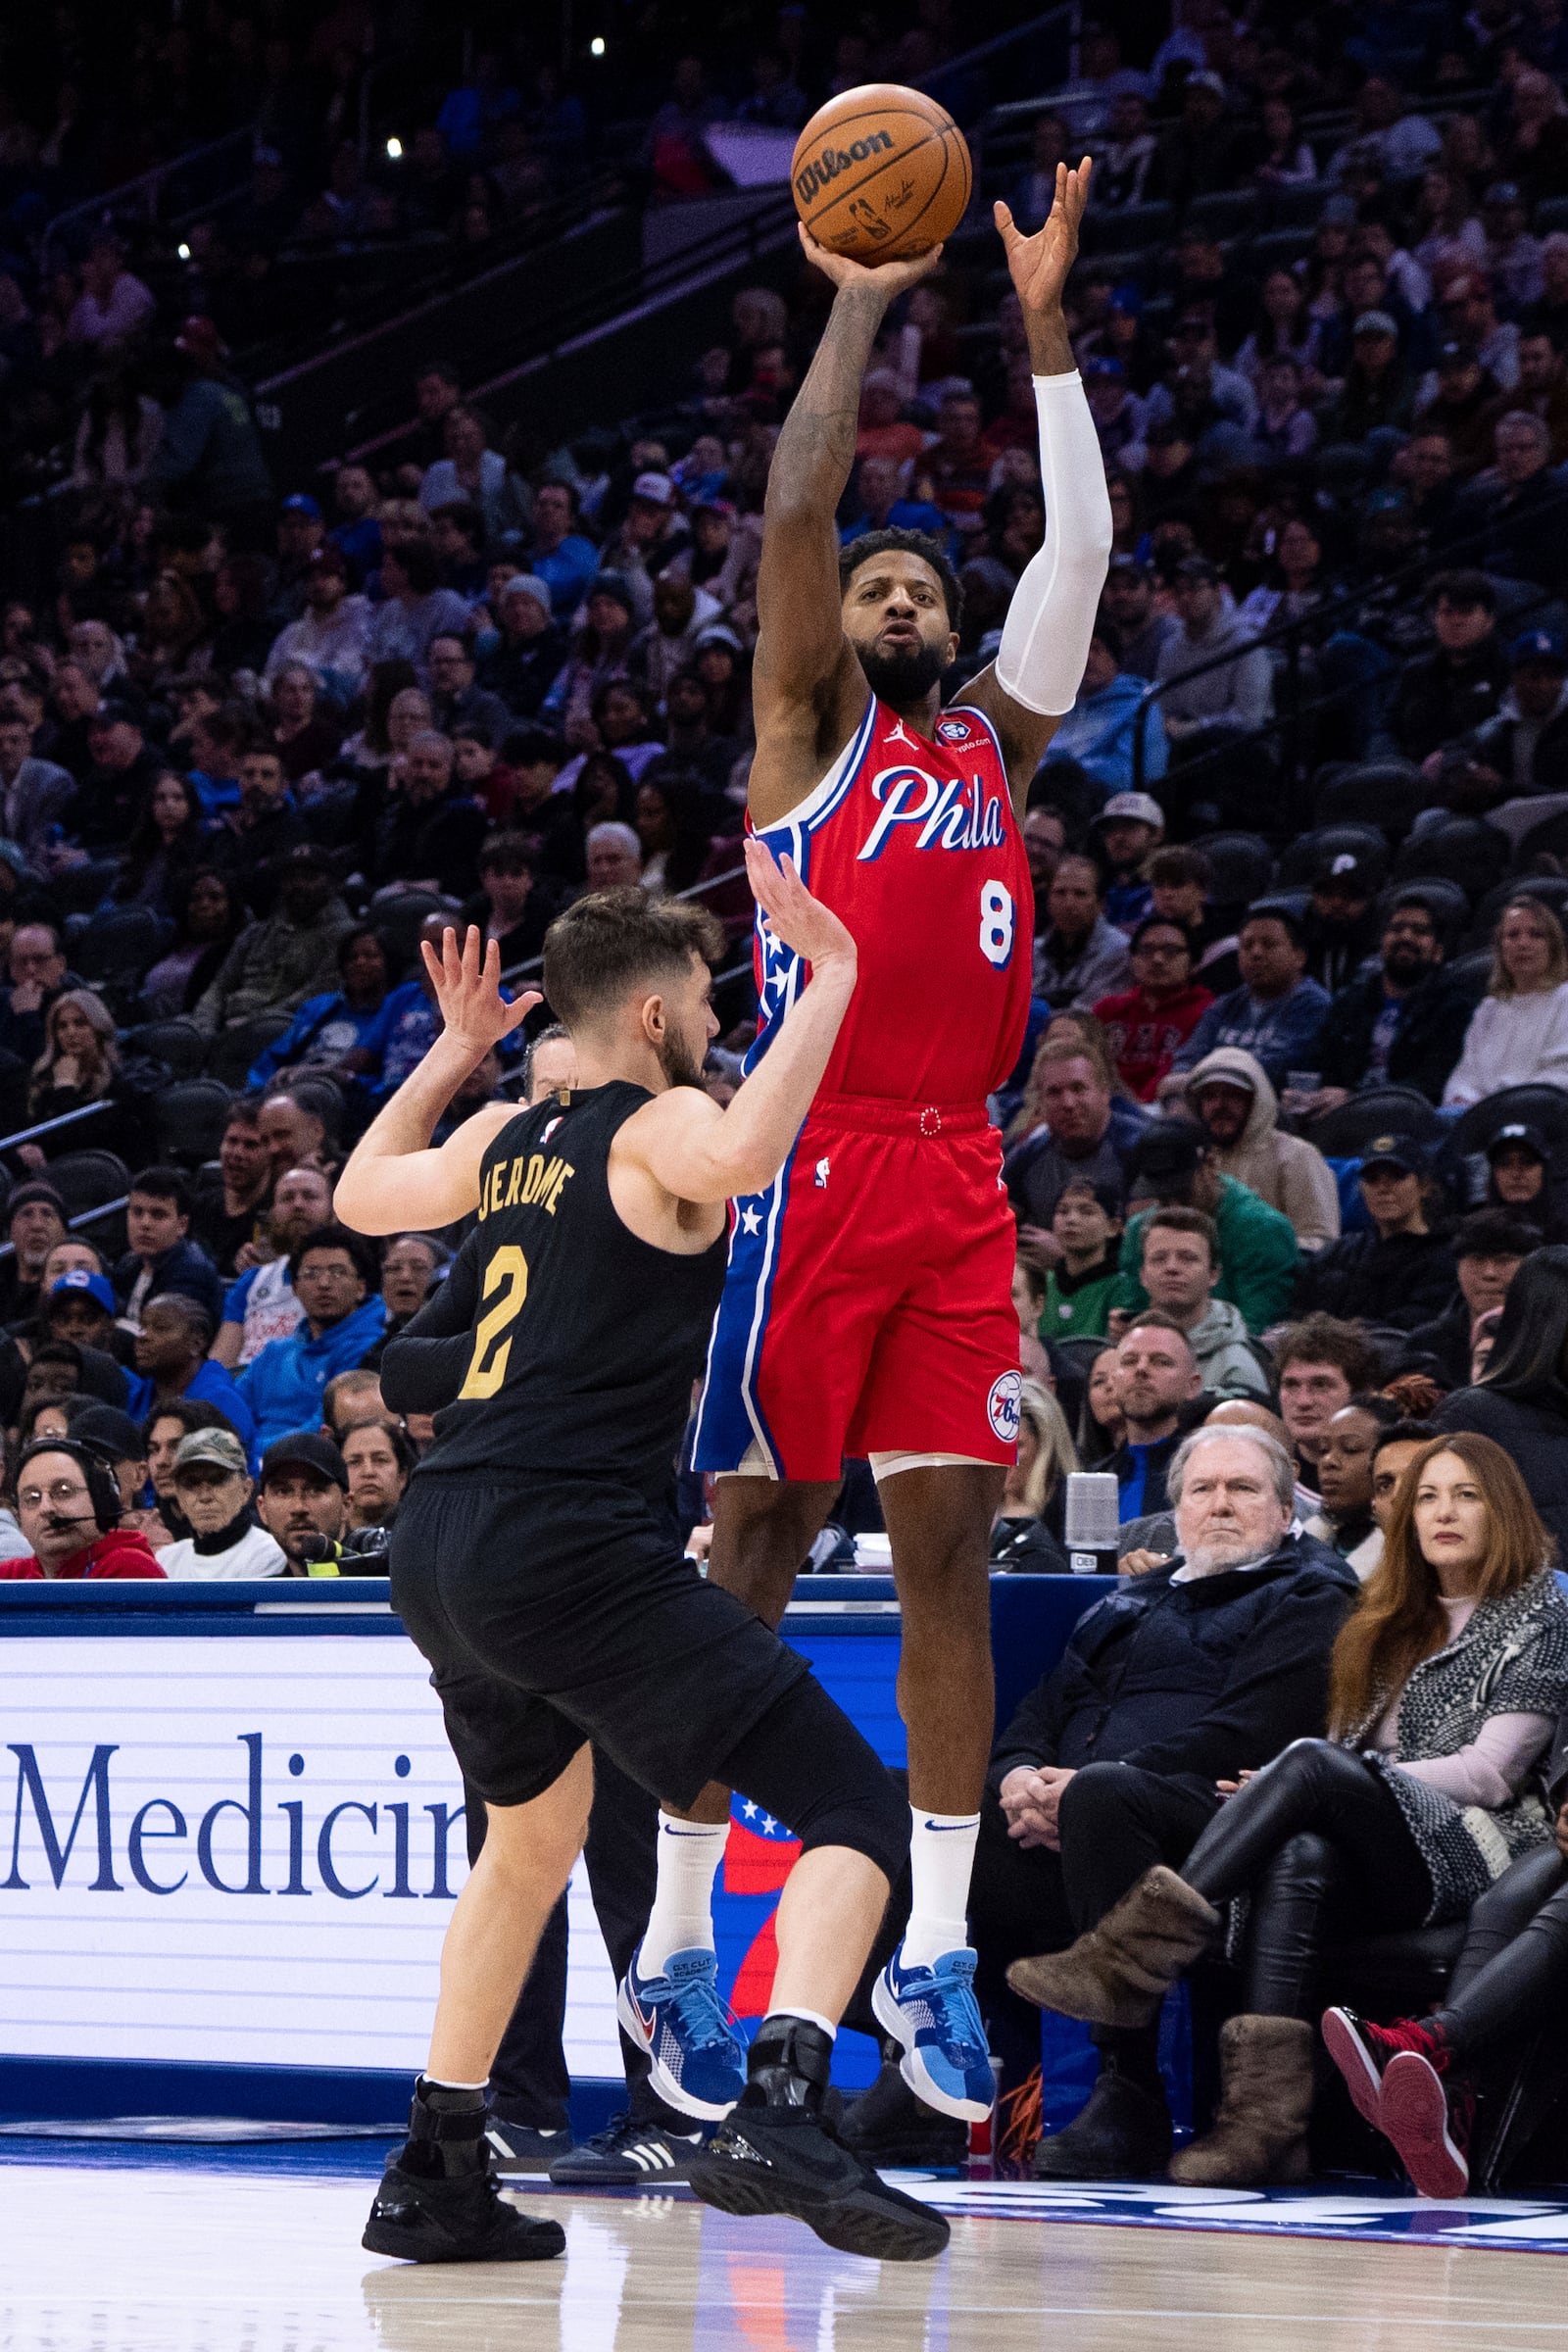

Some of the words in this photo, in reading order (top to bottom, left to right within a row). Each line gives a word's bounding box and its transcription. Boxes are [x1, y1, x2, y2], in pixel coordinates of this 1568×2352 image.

[795, 129, 894, 204] Wilson
[857, 765, 1005, 861] Phila
[980, 879, 1015, 970] 8
[478, 1154, 575, 1222] JEROME
[458, 1246, 528, 1399] 2
[0, 1733, 468, 1899] Medicin
